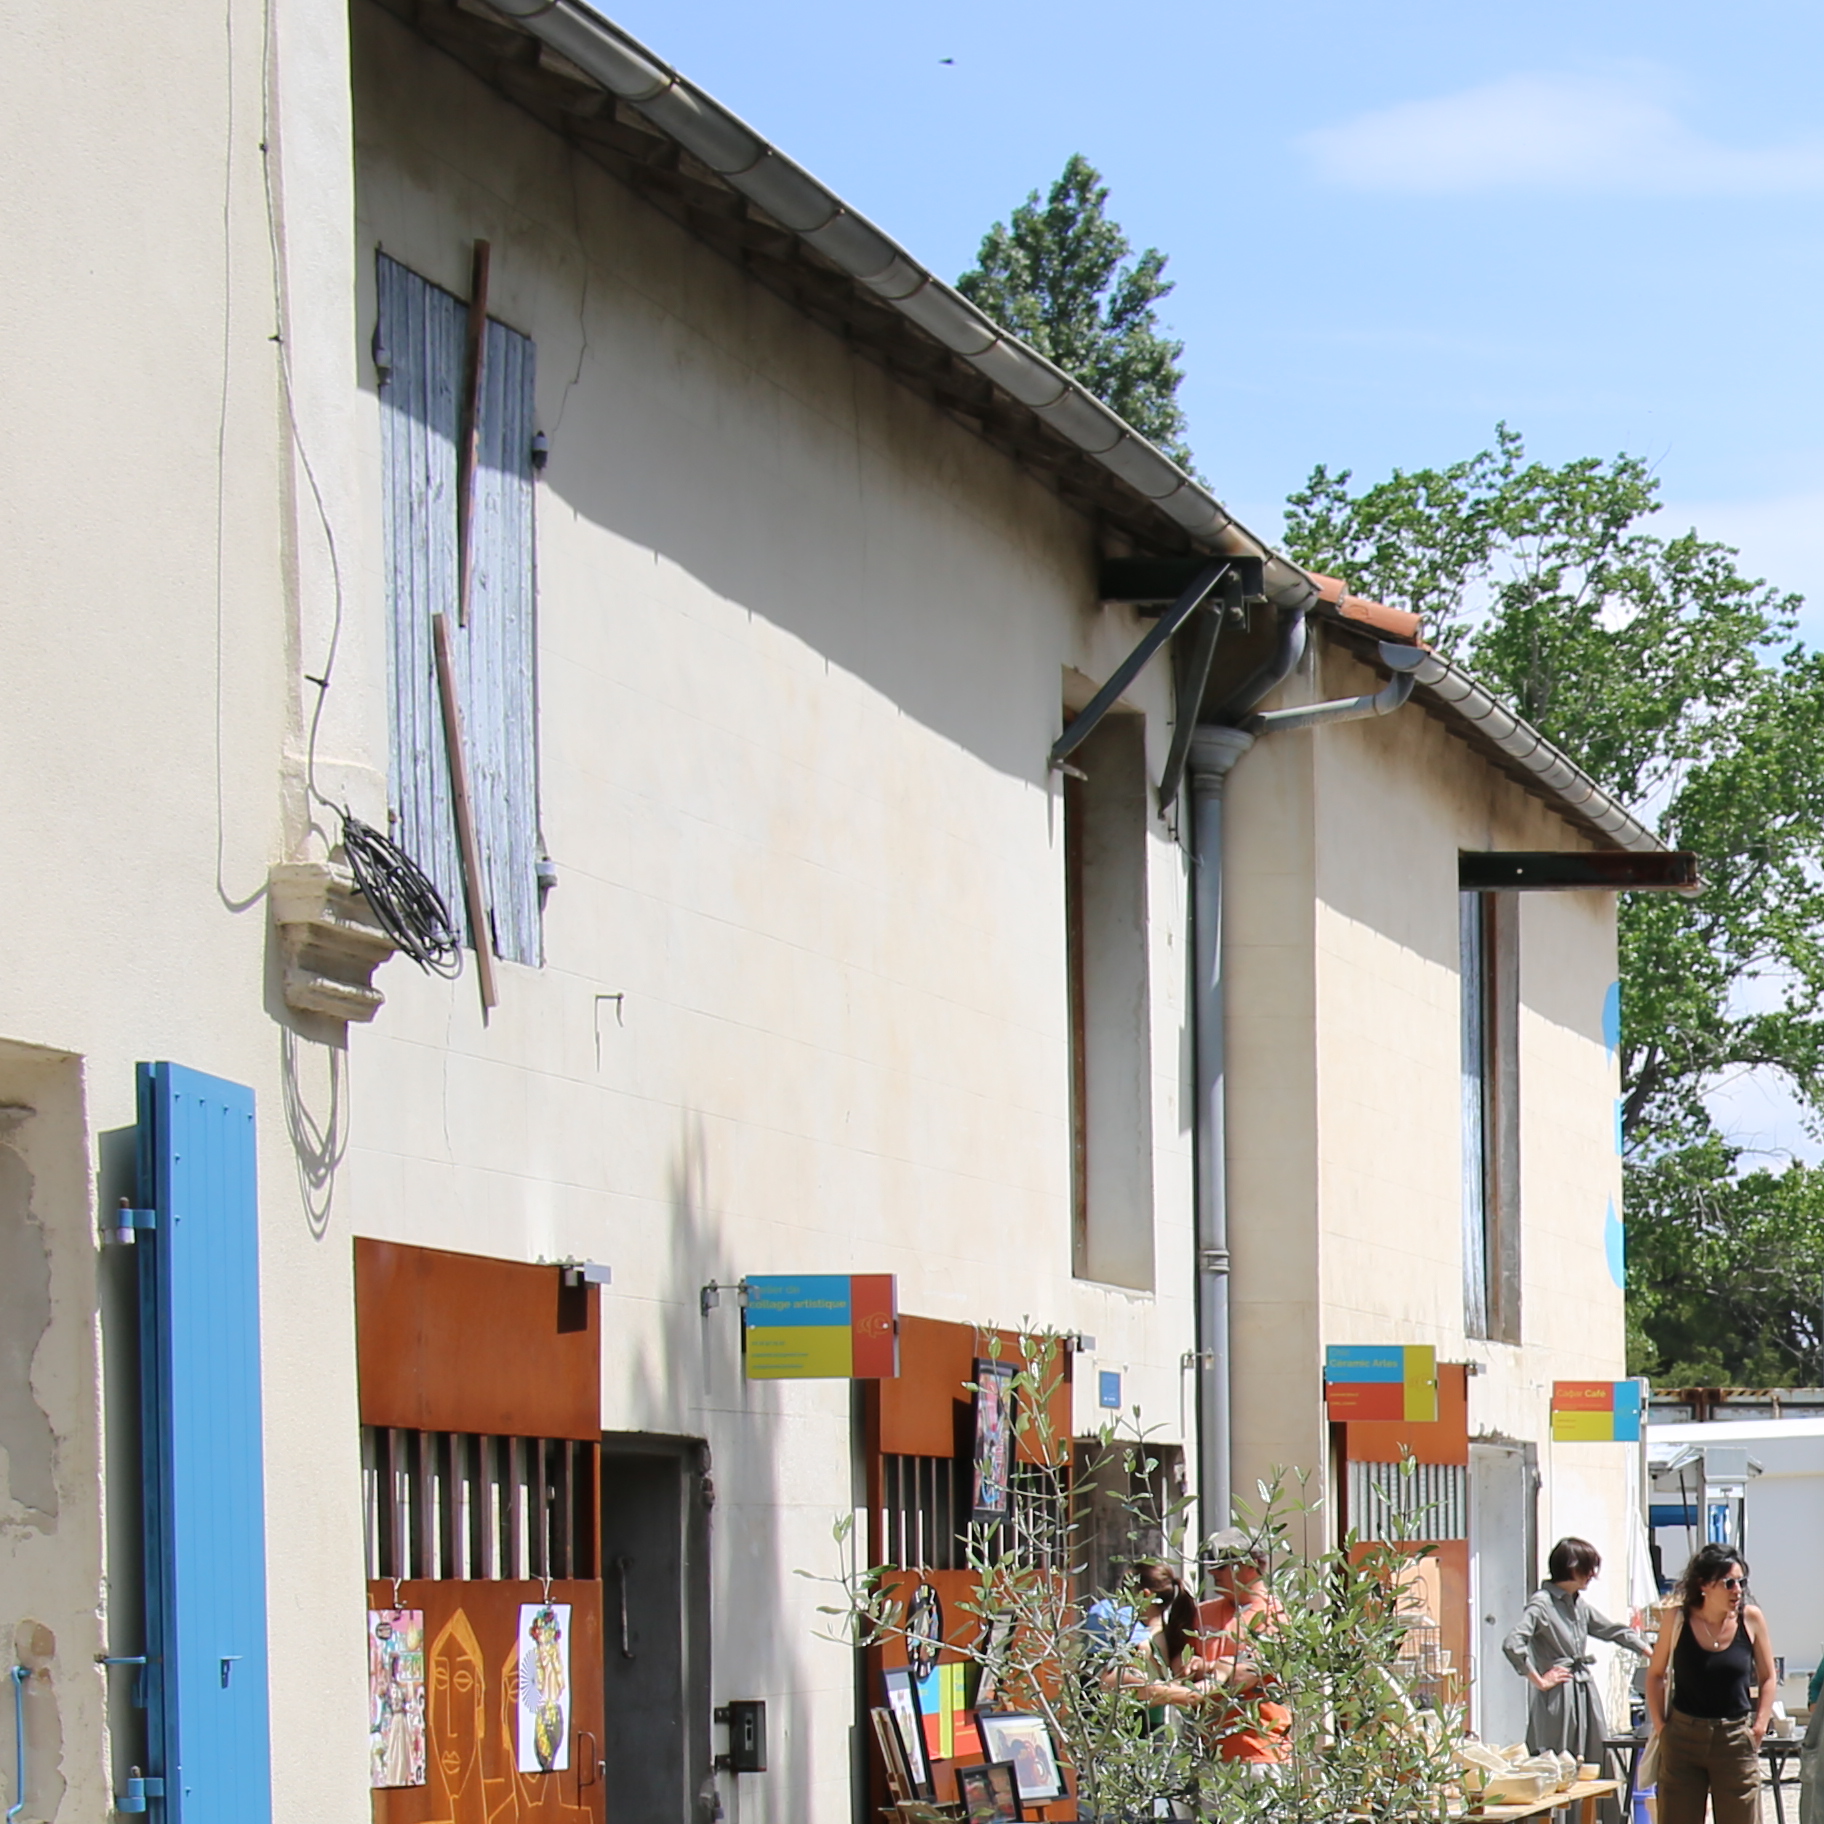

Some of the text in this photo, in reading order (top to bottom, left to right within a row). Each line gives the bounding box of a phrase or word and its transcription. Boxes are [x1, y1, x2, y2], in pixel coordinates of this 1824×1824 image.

[749, 1299, 846, 1311] collage artistique
[1585, 1389, 1606, 1398] Café
